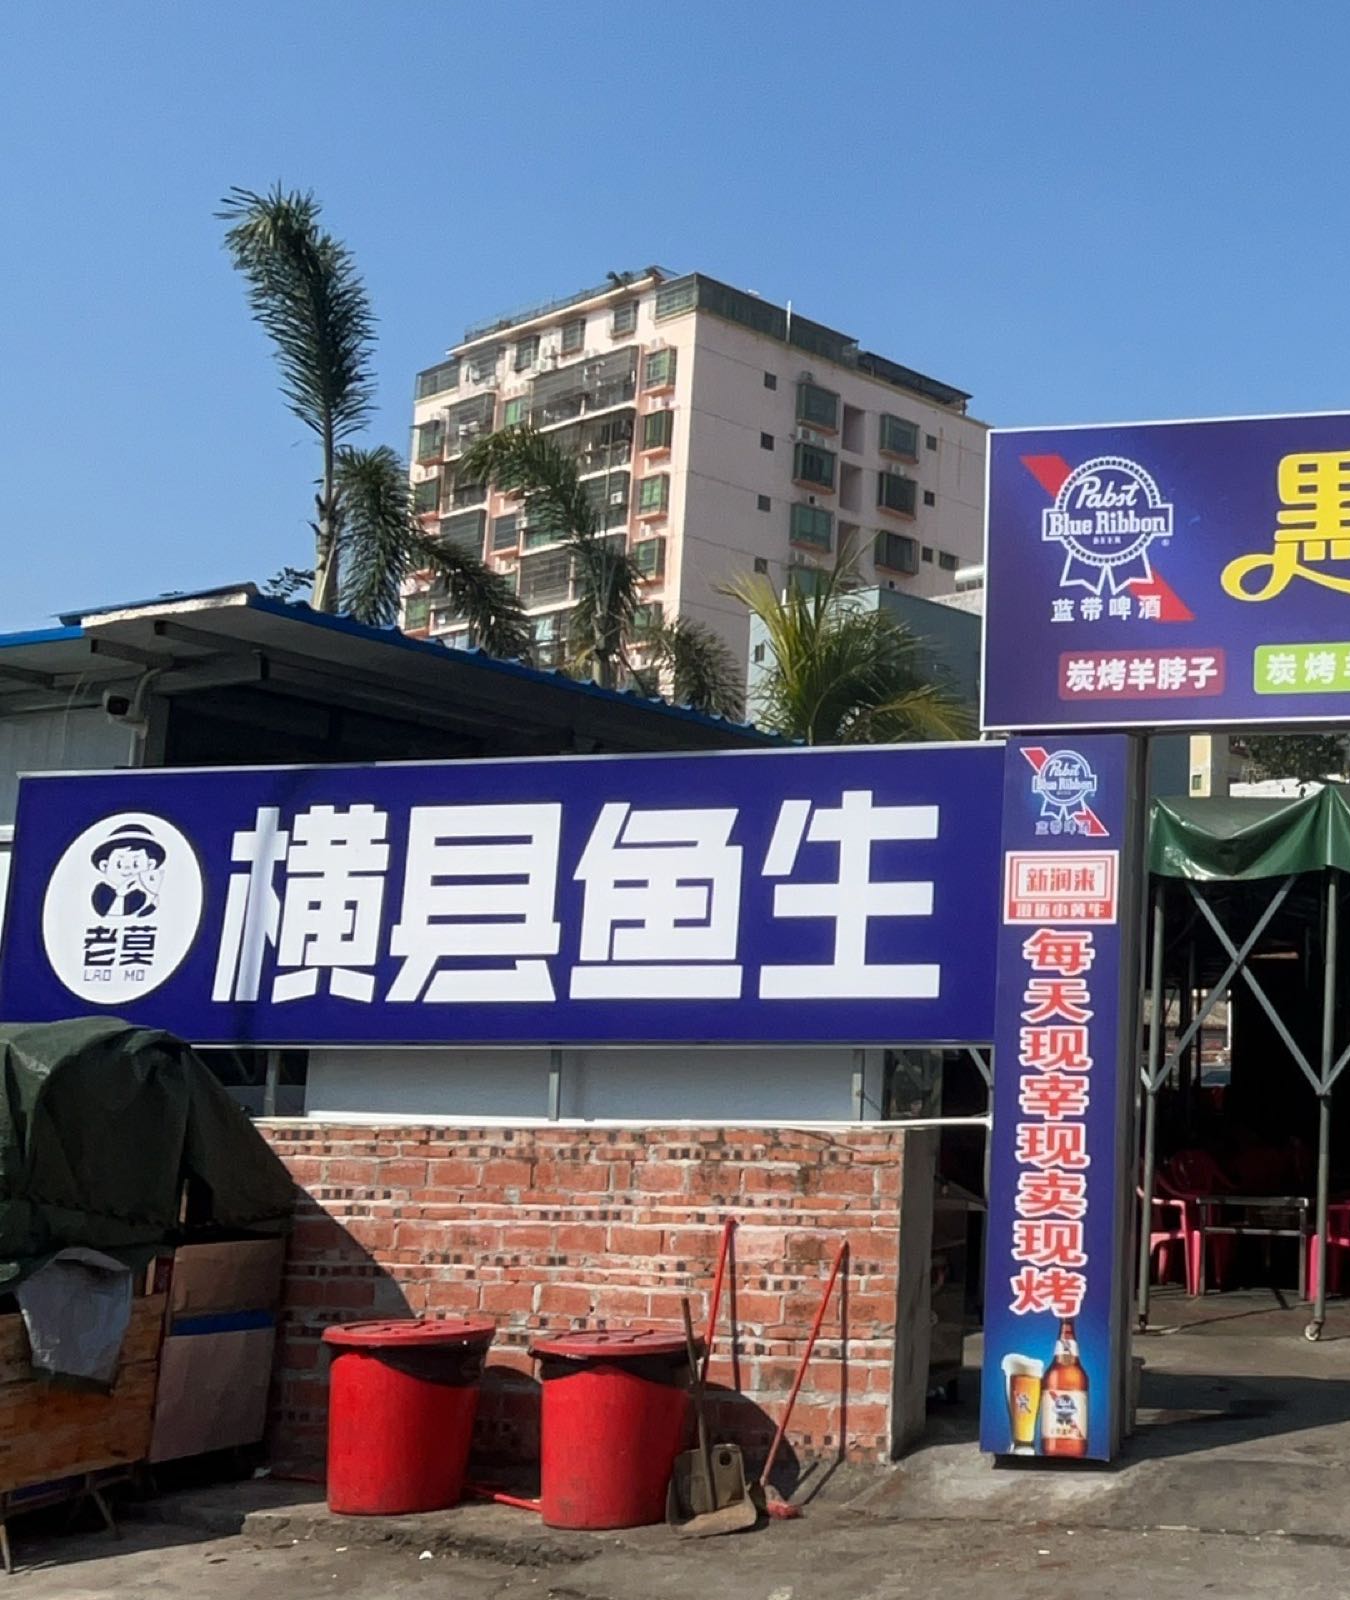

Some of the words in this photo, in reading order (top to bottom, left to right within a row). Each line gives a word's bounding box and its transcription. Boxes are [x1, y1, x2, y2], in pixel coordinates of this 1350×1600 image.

[1076, 476, 1140, 509] Pabst
[1049, 513, 1092, 535] Blue
[1095, 510, 1165, 534] Ribbon
[1051, 595, 1161, 622] 蓝带啤酒
[1066, 656, 1218, 692] 炭烤羊脖子
[211, 791, 939, 1003] 横县鱼生
[84, 925, 157, 966] 老莫
[124, 969, 145, 981] MO
[1010, 928, 1095, 1318] 每天现宰现卖现烤
